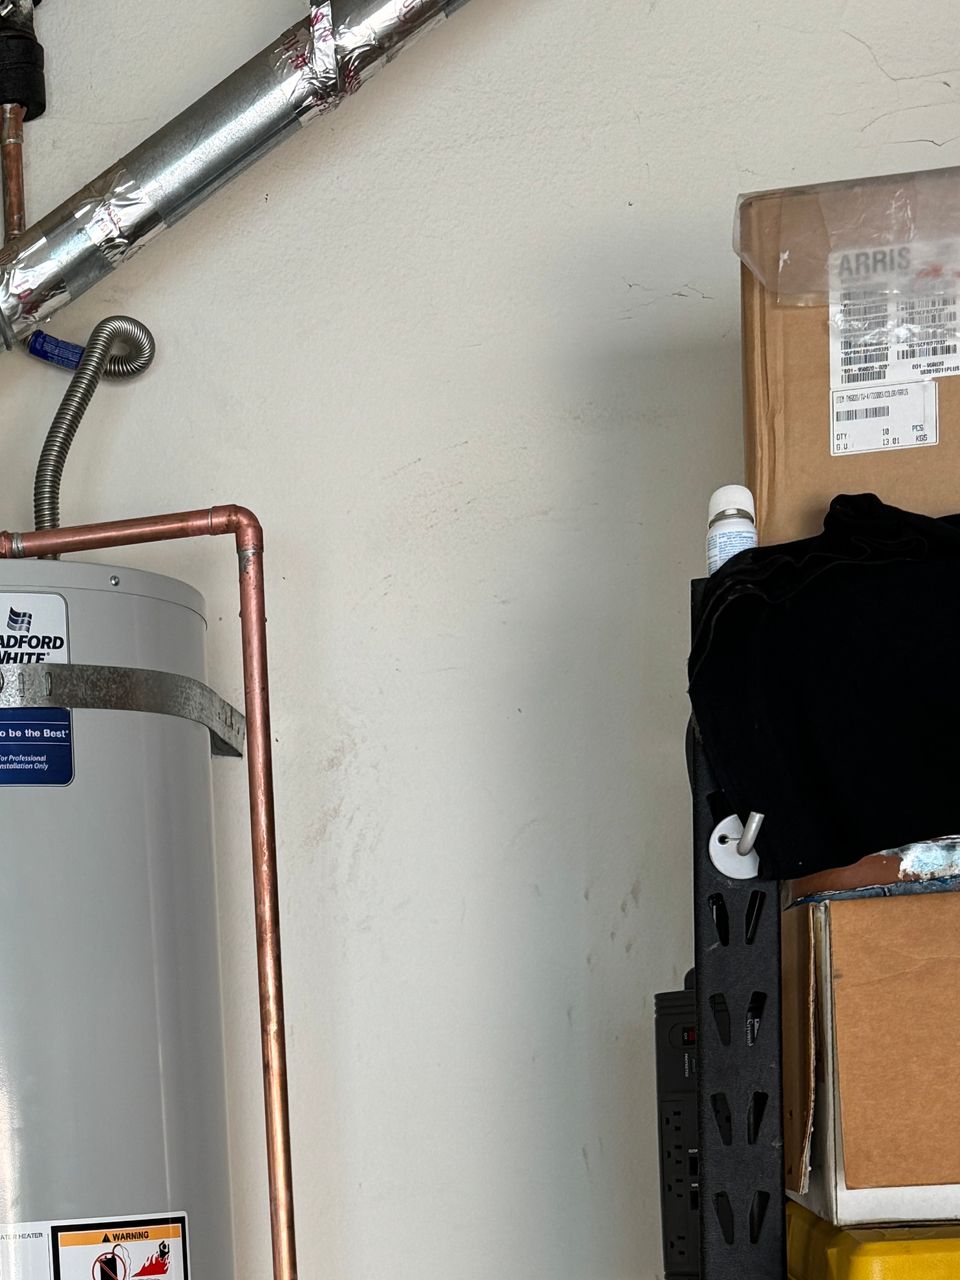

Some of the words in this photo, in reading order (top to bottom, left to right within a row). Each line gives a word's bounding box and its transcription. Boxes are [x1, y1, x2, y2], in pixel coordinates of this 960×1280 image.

[839, 247, 911, 276] ARRIS
[8, 729, 21, 737] be
[25, 729, 40, 737] the
[34, 763, 48, 771] Only
[112, 1231, 149, 1240] WARNING
